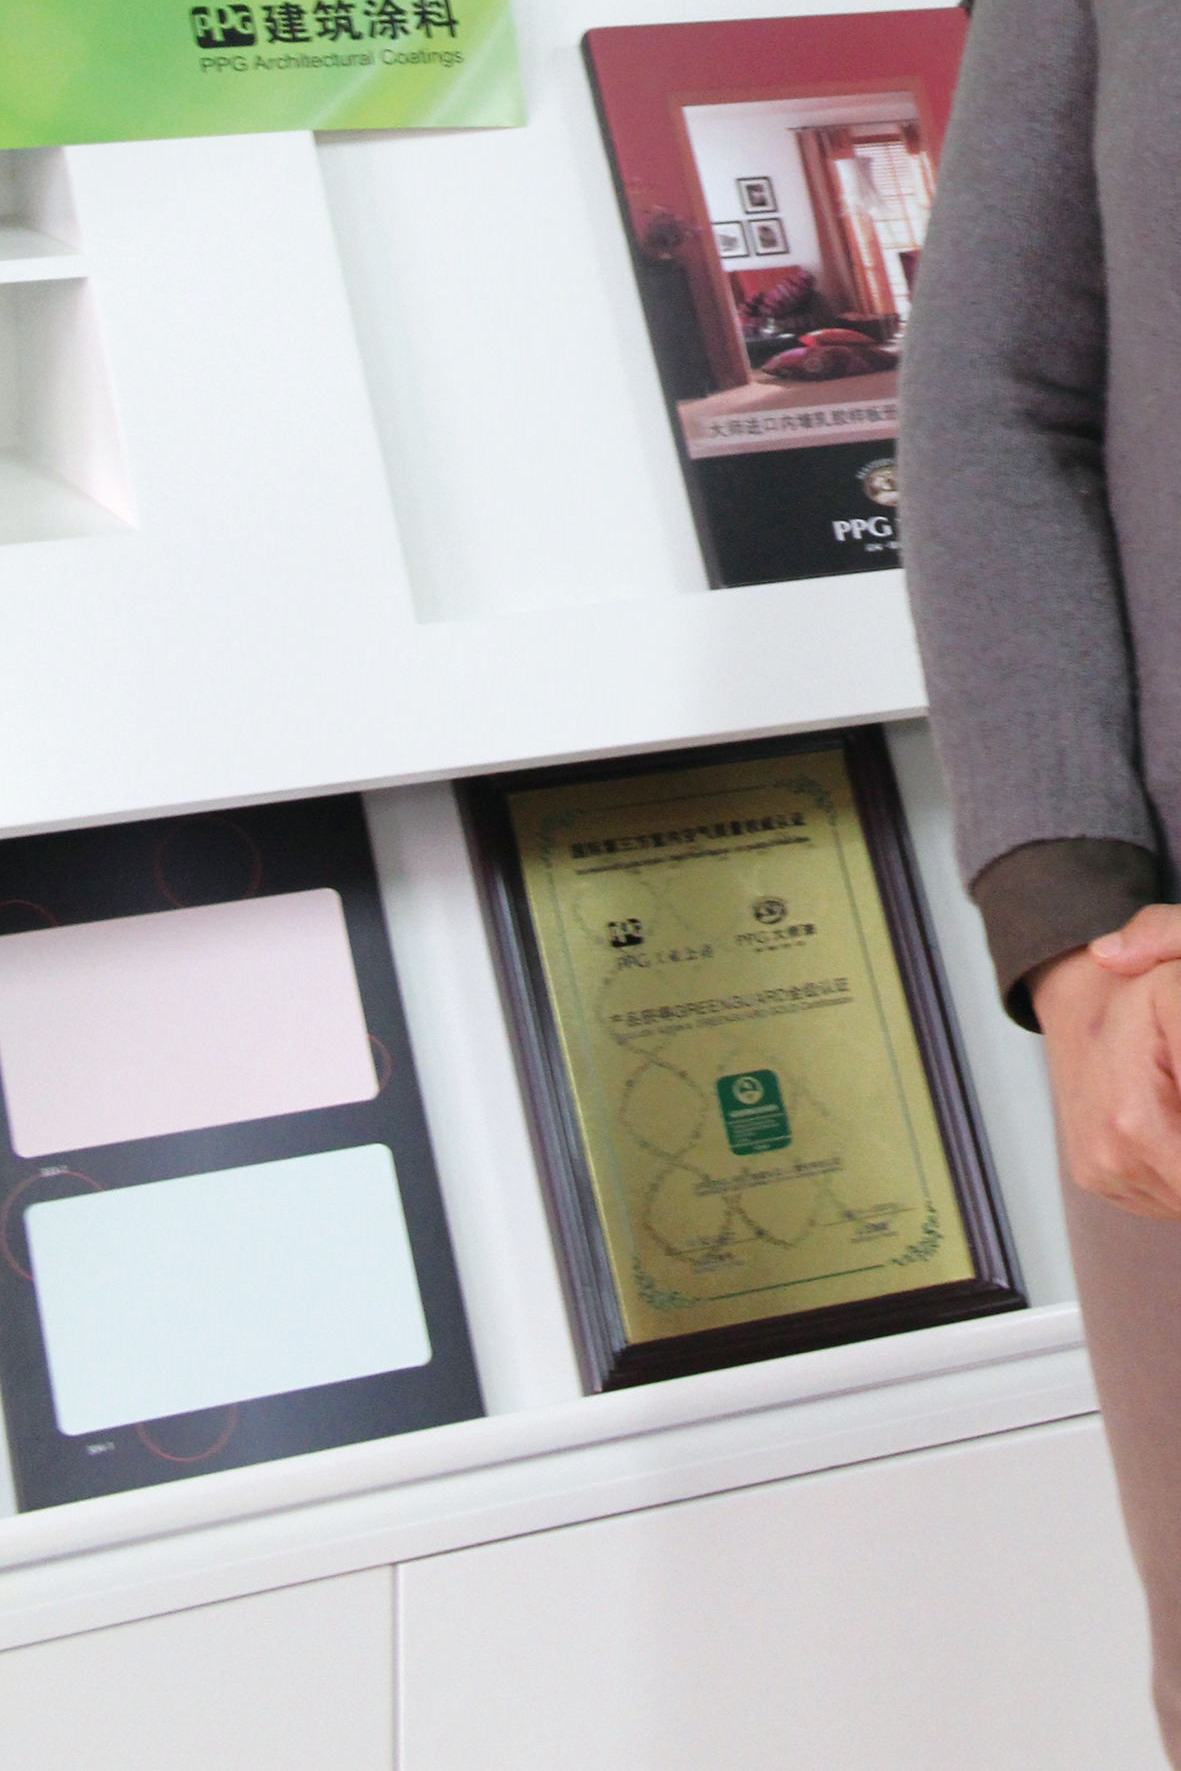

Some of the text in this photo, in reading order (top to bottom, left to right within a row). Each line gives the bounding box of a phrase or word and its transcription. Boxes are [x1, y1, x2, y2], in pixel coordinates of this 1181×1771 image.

[201, 47, 464, 73] PPG Architectural Coatings
[832, 515, 893, 542] PPG
